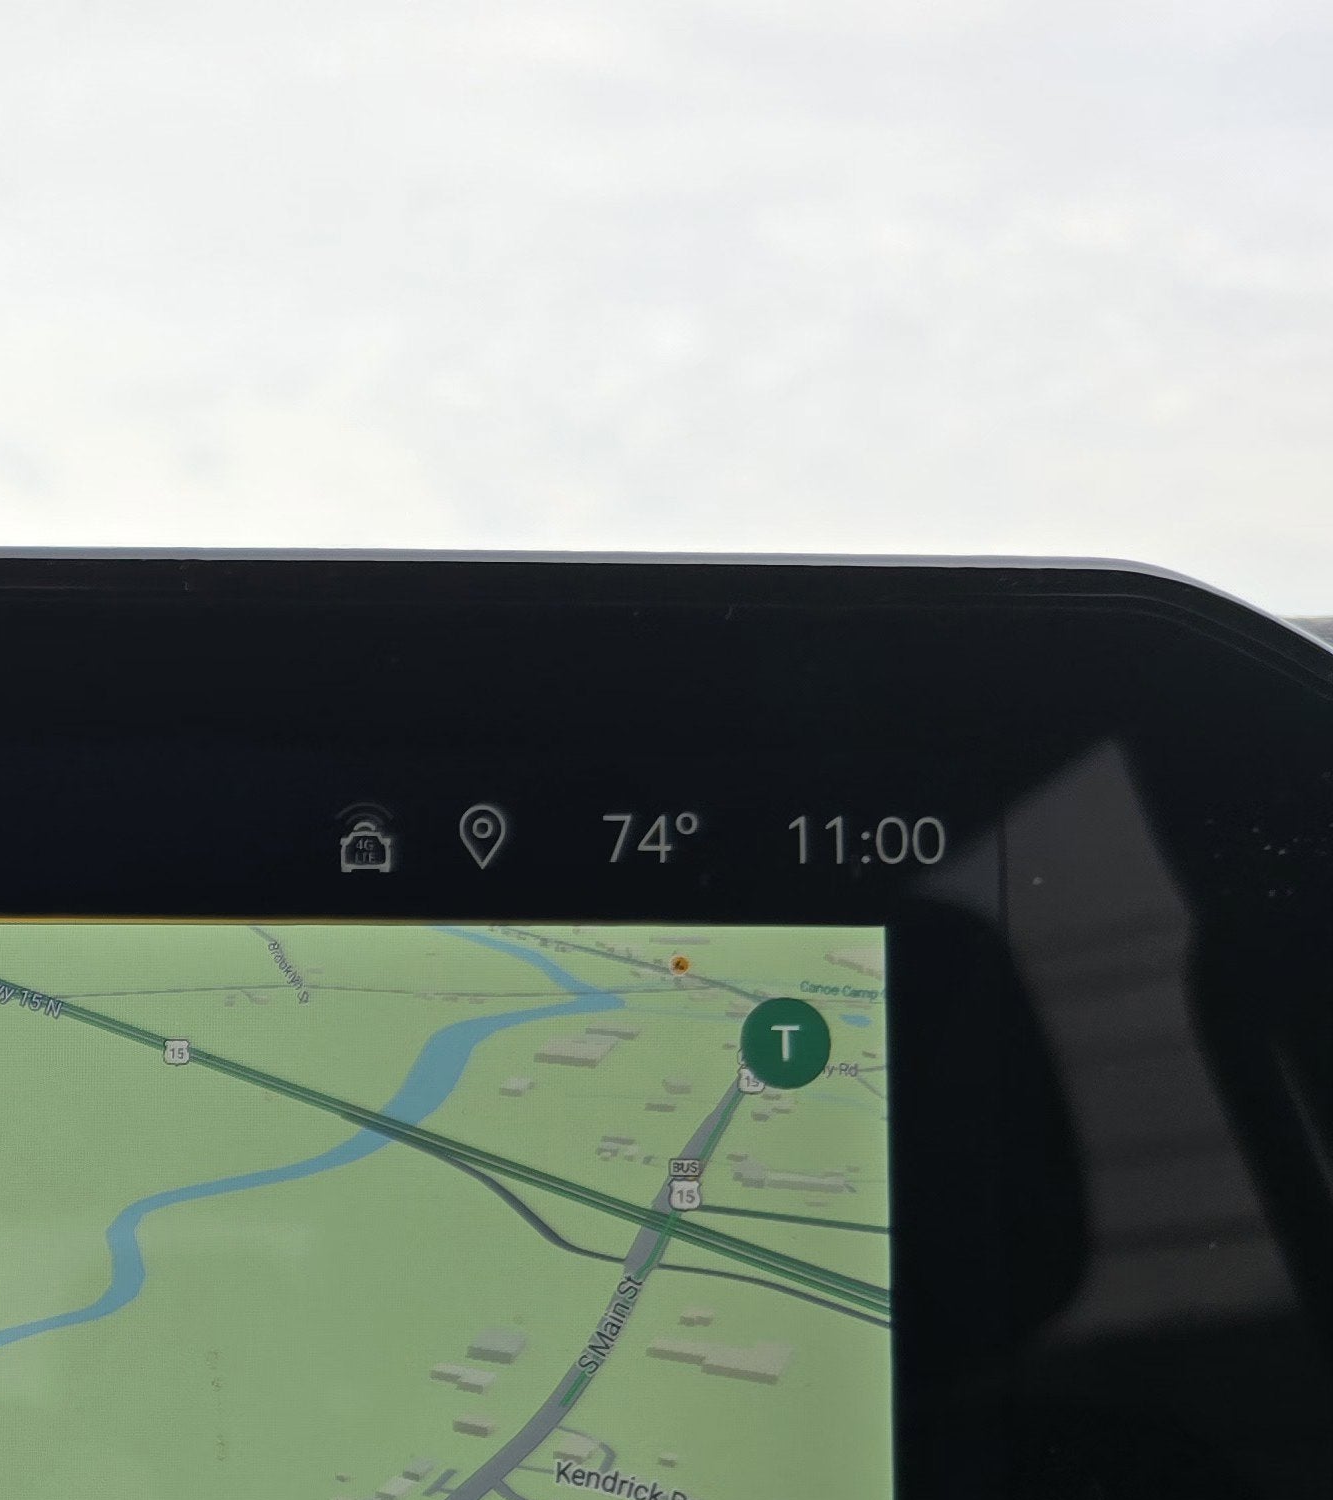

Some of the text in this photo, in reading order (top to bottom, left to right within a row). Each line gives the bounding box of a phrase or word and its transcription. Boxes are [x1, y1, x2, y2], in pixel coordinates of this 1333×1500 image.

[788, 815, 947, 864] 11:00
[19, 989, 43, 1012] 15
[45, 999, 64, 1020] N
[168, 1049, 185, 1061] 15
[770, 1024, 801, 1063] T
[838, 1062, 859, 1078] Rd
[673, 1162, 699, 1174] BUS
[677, 1189, 696, 1205] 15
[578, 1275, 644, 1375] S Main St
